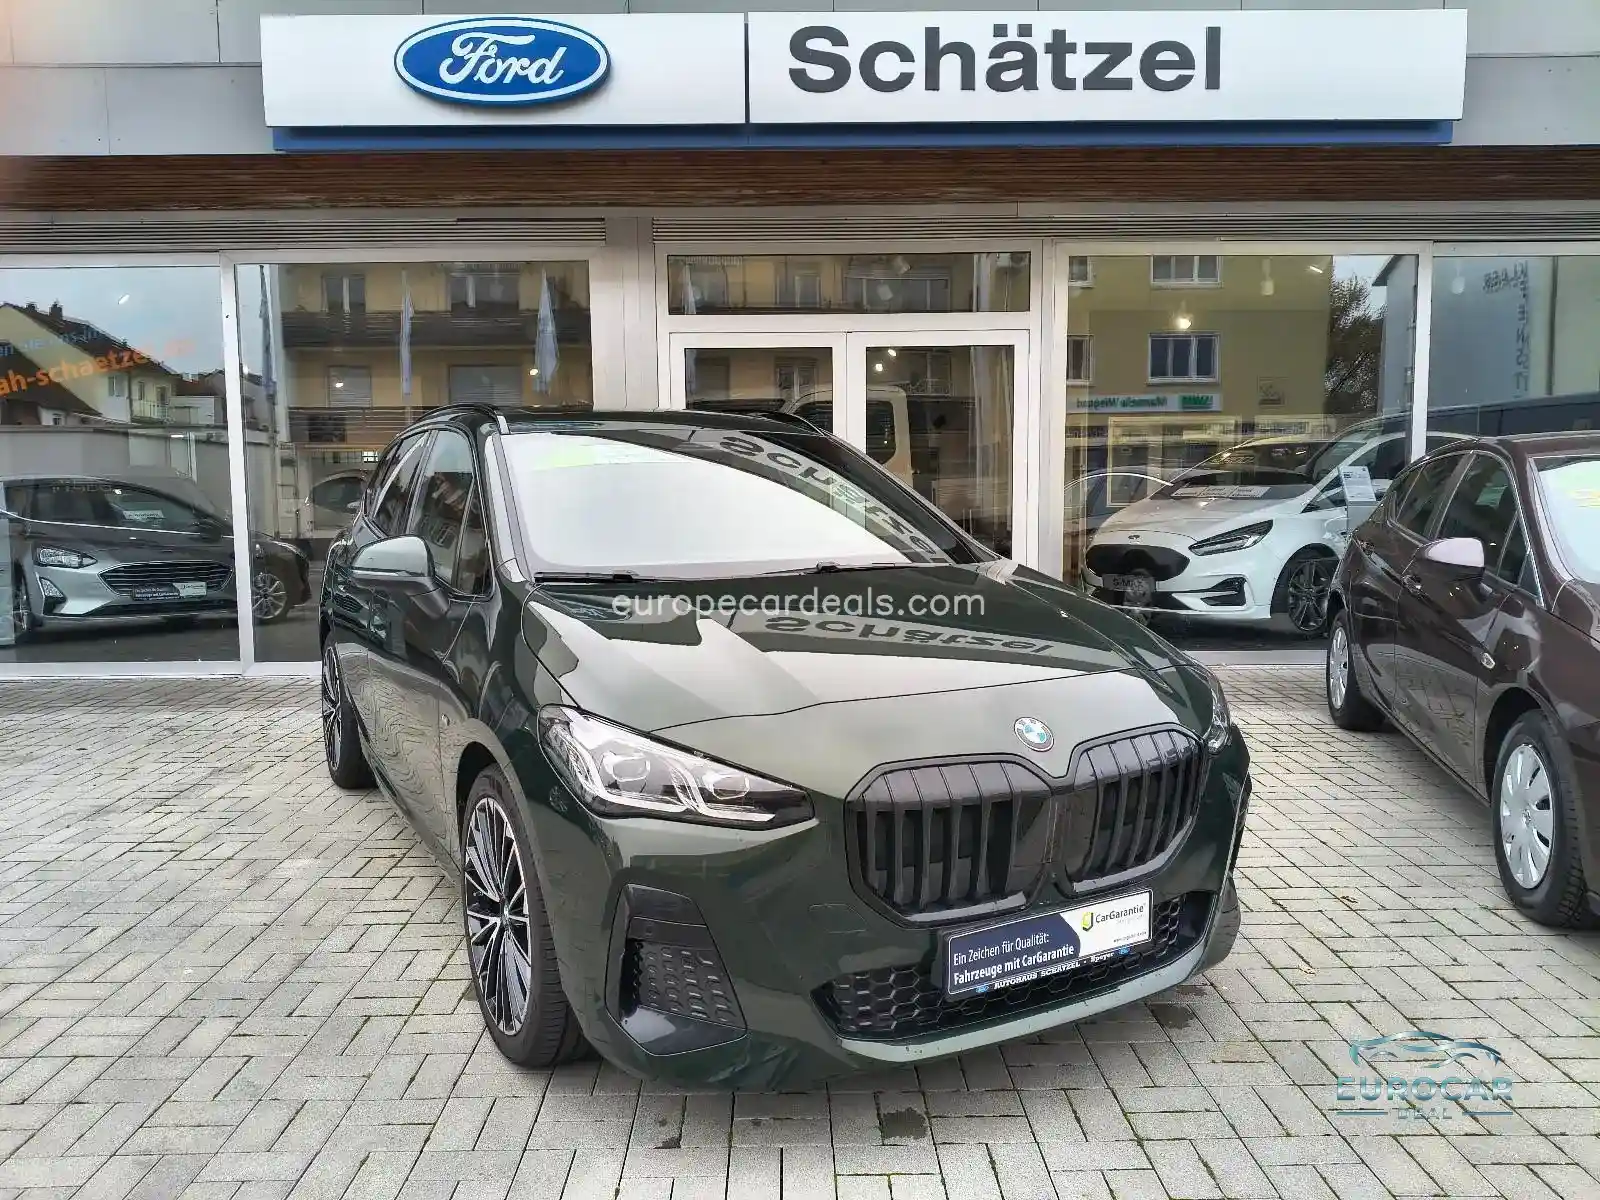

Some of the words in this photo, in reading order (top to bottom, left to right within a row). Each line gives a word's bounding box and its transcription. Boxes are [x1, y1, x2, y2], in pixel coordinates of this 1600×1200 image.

[438, 31, 566, 86] Ford
[787, 24, 1223, 93] Schätzel
[1095, 904, 1145, 924] CarGarantie
[953, 952, 967, 966] Ein
[968, 944, 1000, 962] Zeichen
[1001, 939, 1014, 954] für
[1015, 932, 1050, 951] Qualität:
[953, 962, 1003, 985] Fahrzeuge
[1004, 957, 1021, 972] mit
[1021, 943, 1075, 967] CarGarantie
